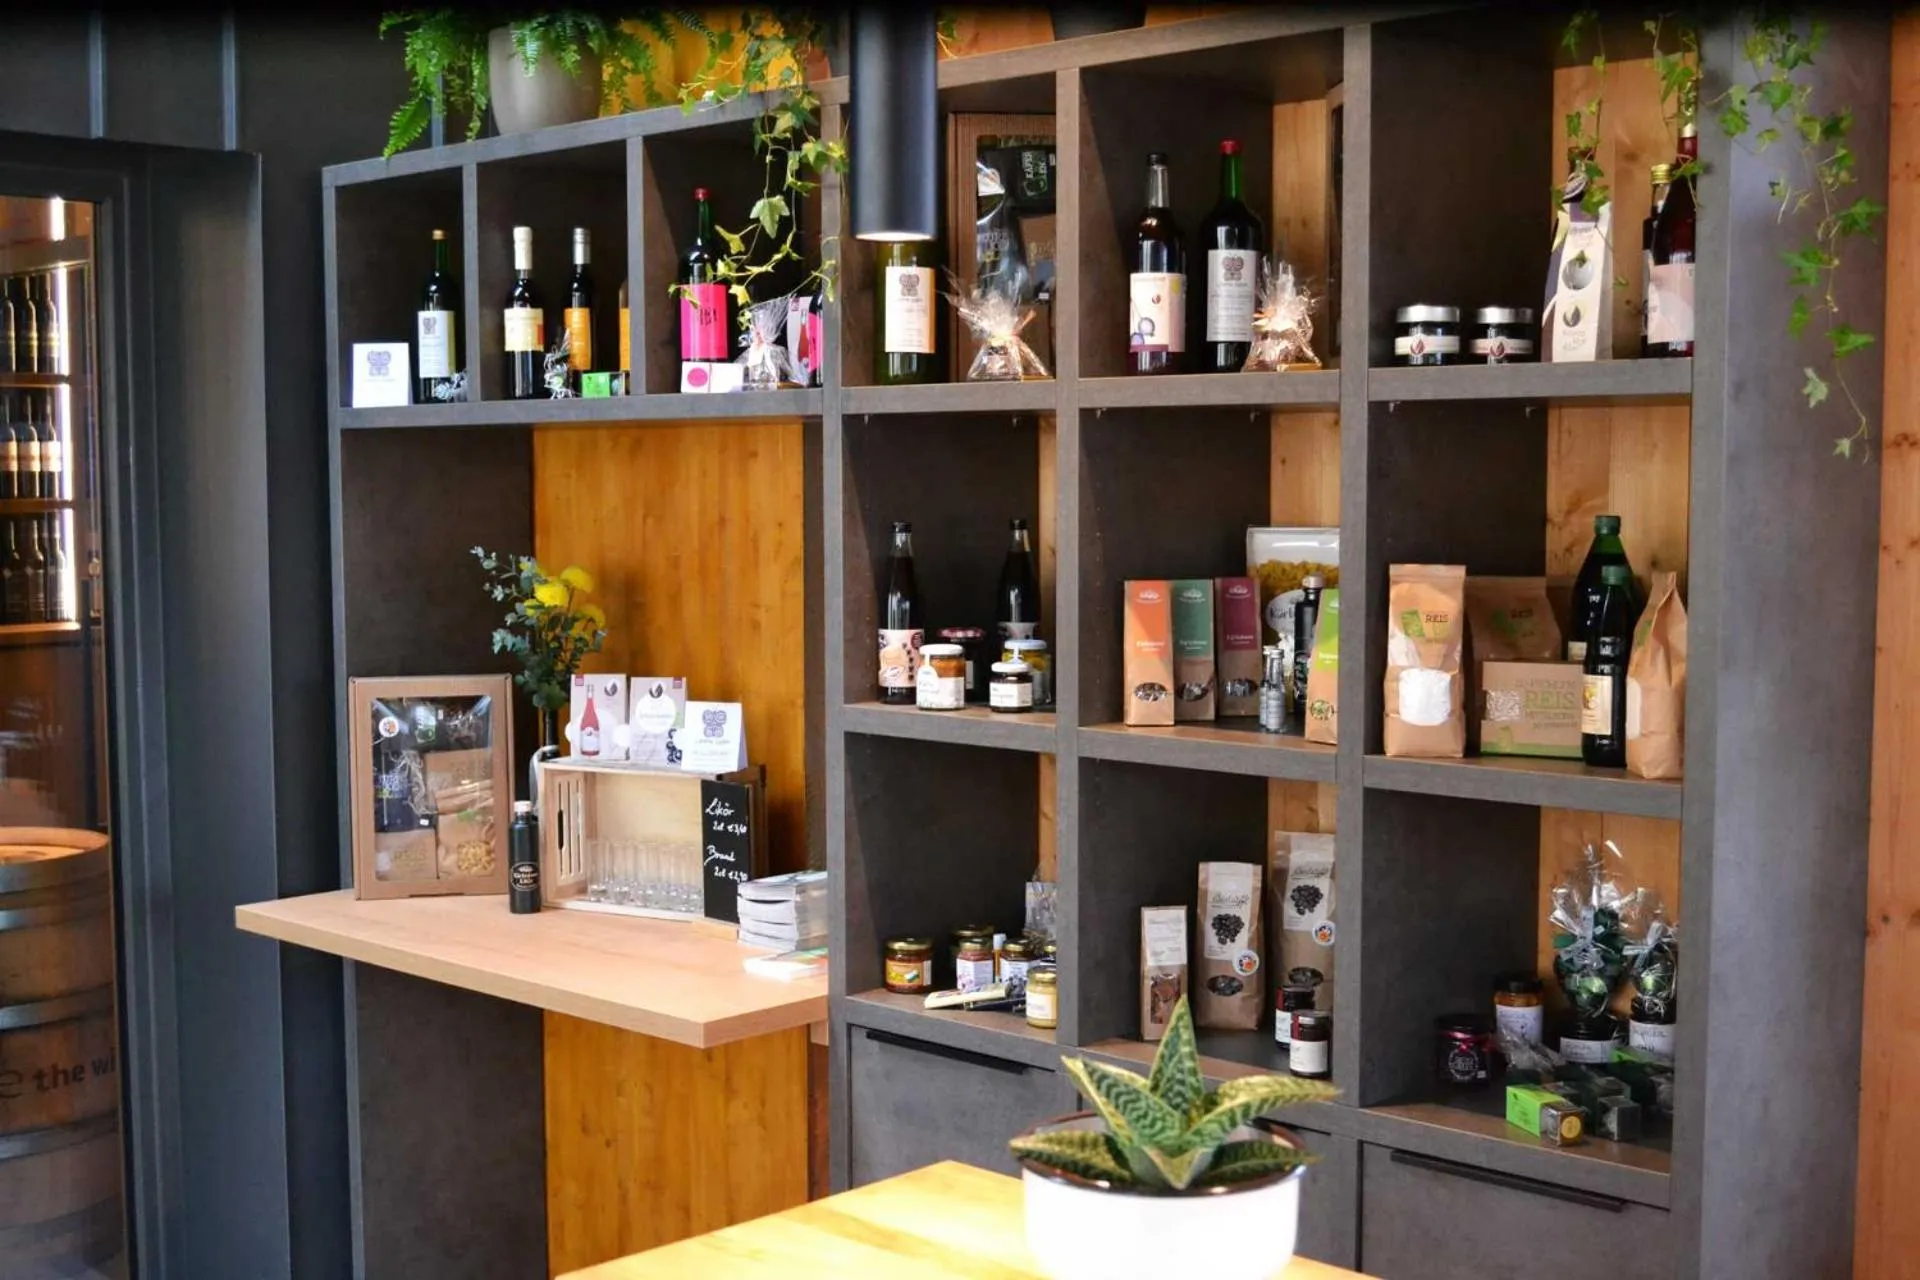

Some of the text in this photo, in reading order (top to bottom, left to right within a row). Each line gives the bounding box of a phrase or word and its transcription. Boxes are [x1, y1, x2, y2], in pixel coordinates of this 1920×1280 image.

[1524, 690, 1576, 710] REIS
[705, 797, 735, 816] Likör
[703, 844, 736, 867] Brand
[32, 1062, 86, 1092] the
